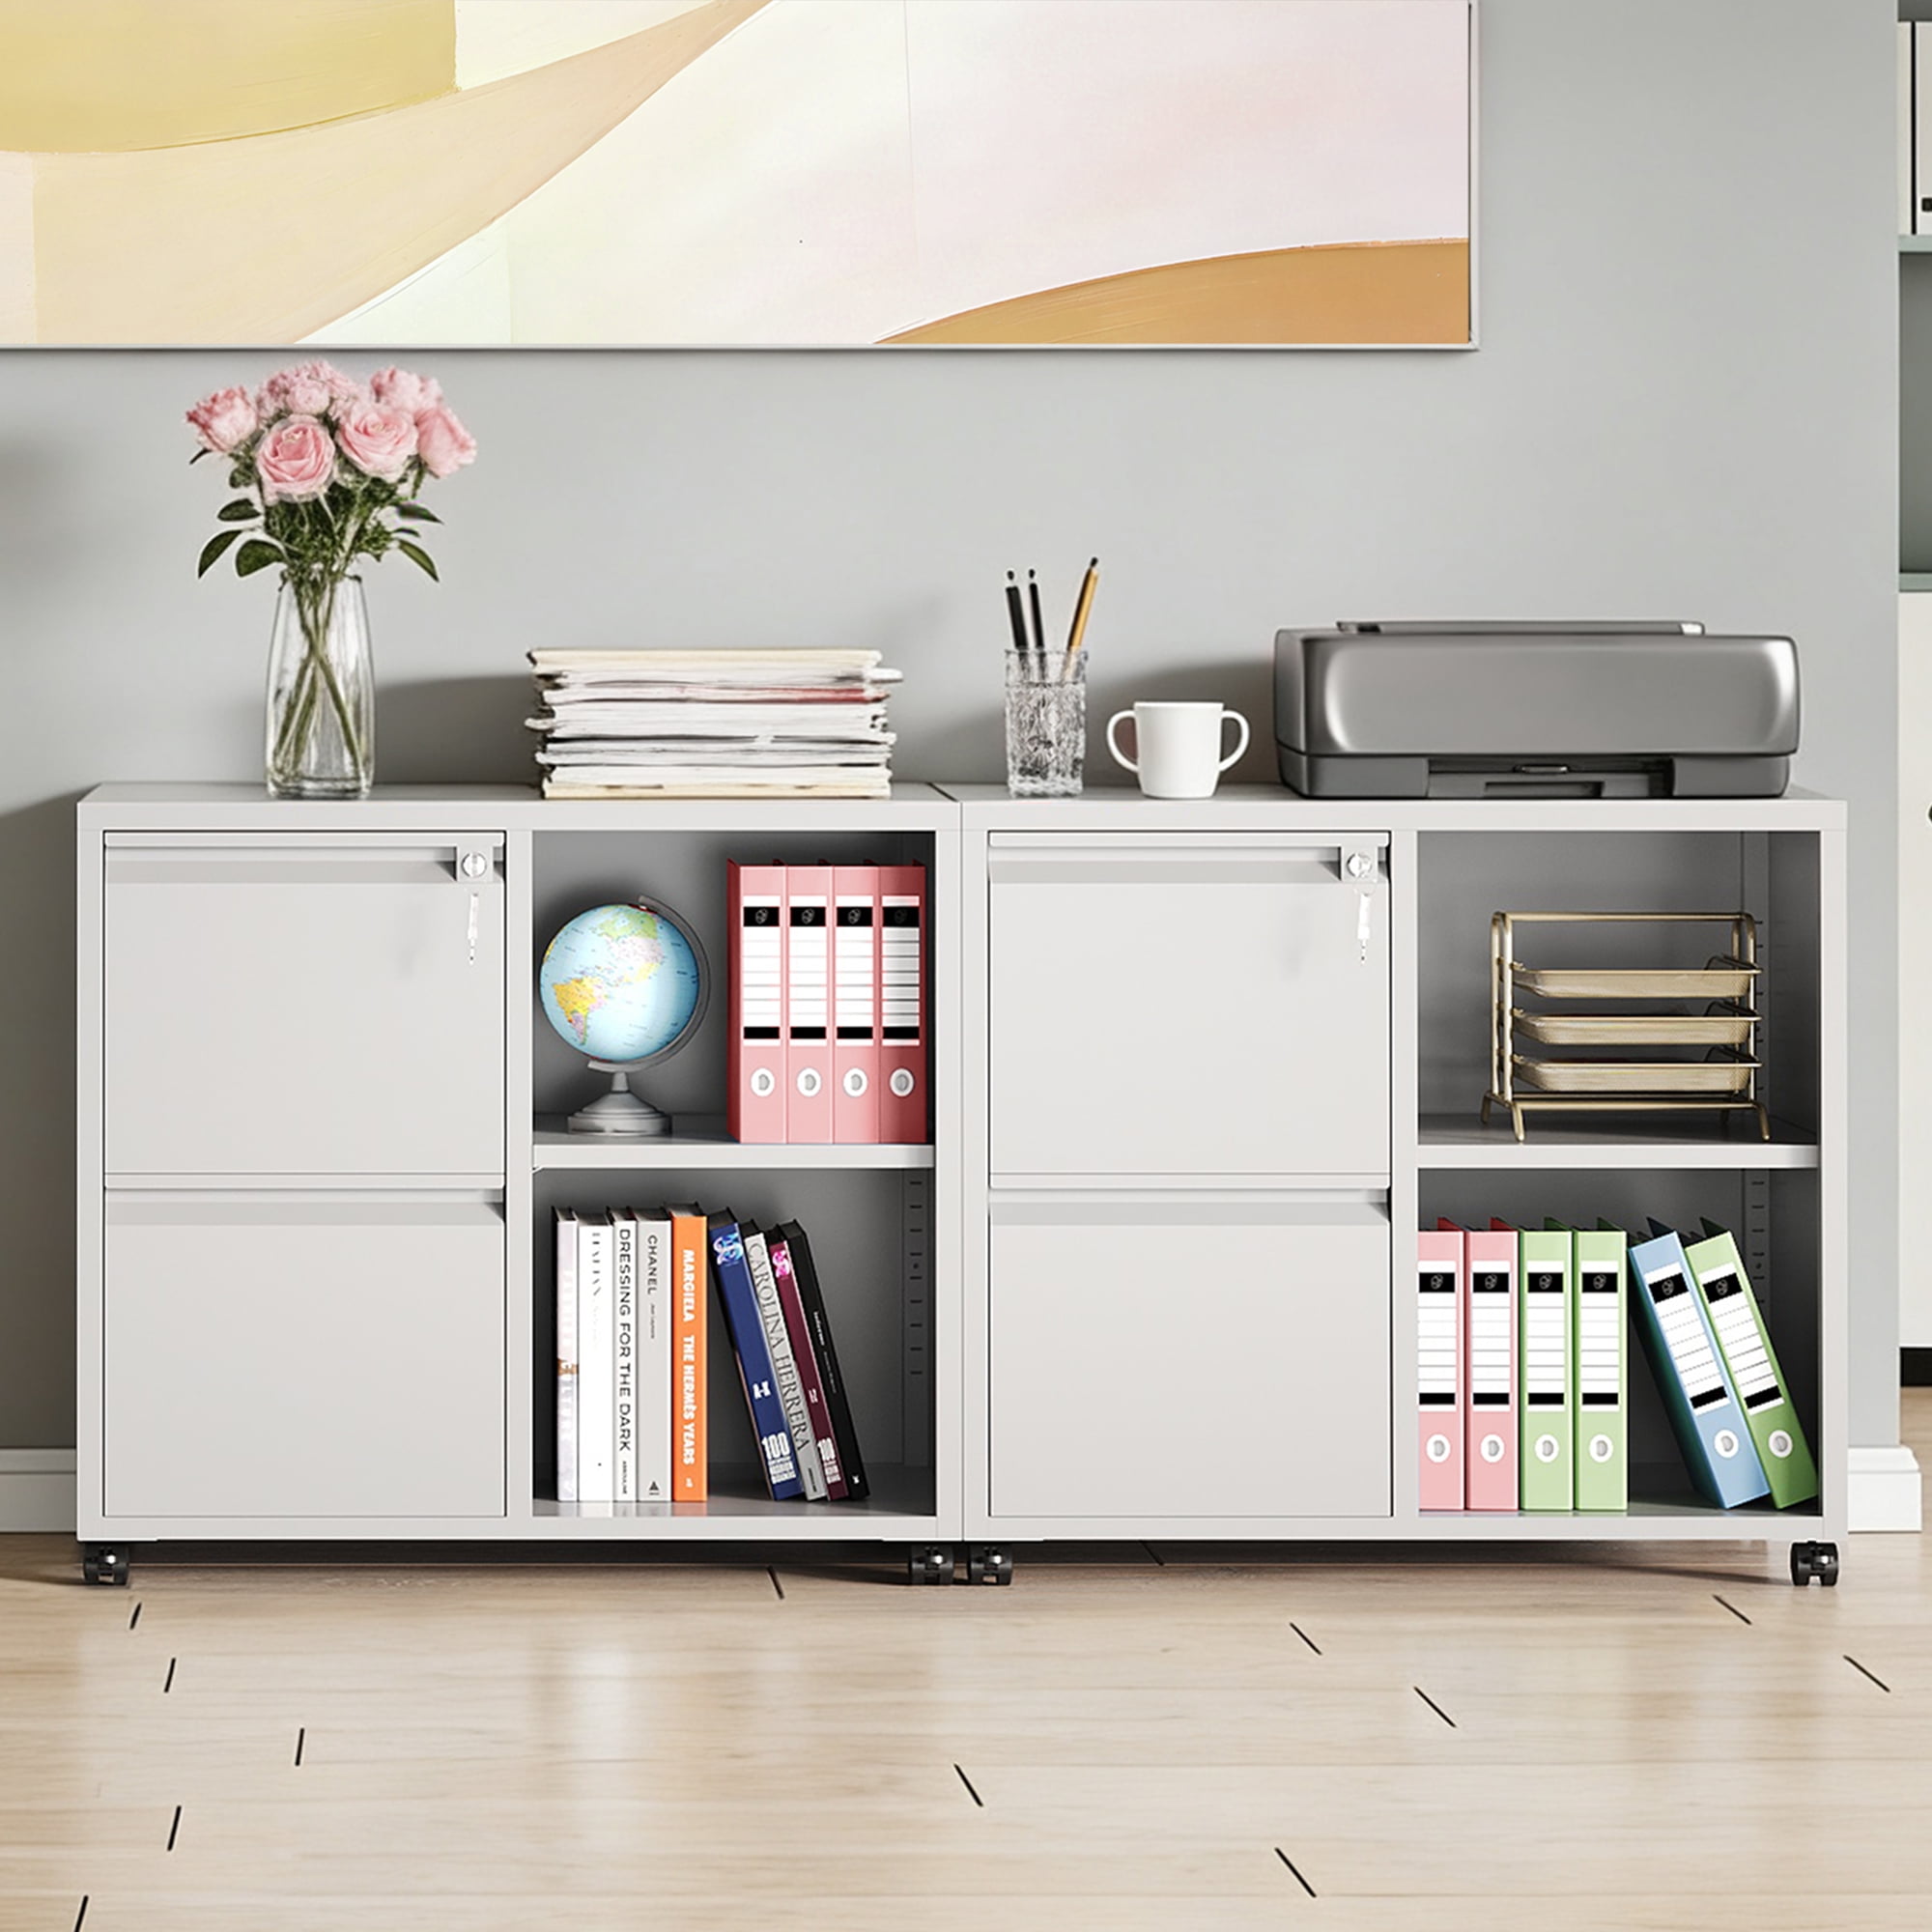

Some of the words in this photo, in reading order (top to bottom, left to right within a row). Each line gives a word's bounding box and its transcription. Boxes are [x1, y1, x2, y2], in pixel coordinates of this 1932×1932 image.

[619, 1229, 631, 1317] DRESSING
[647, 1235, 658, 1295] CHANEL
[683, 1249, 695, 1322] MARGIELA
[619, 1323, 631, 1358] FOR
[683, 1335, 695, 1363] THE
[748, 1242, 785, 1350] CAROLINA
[775, 1355, 810, 1451] HERRERA
[619, 1363, 631, 1397] THE
[683, 1365, 696, 1420] HERMÈS
[619, 1404, 631, 1452] DARK
[683, 1422, 695, 1464] YEARS
[761, 1432, 790, 1460] 100
